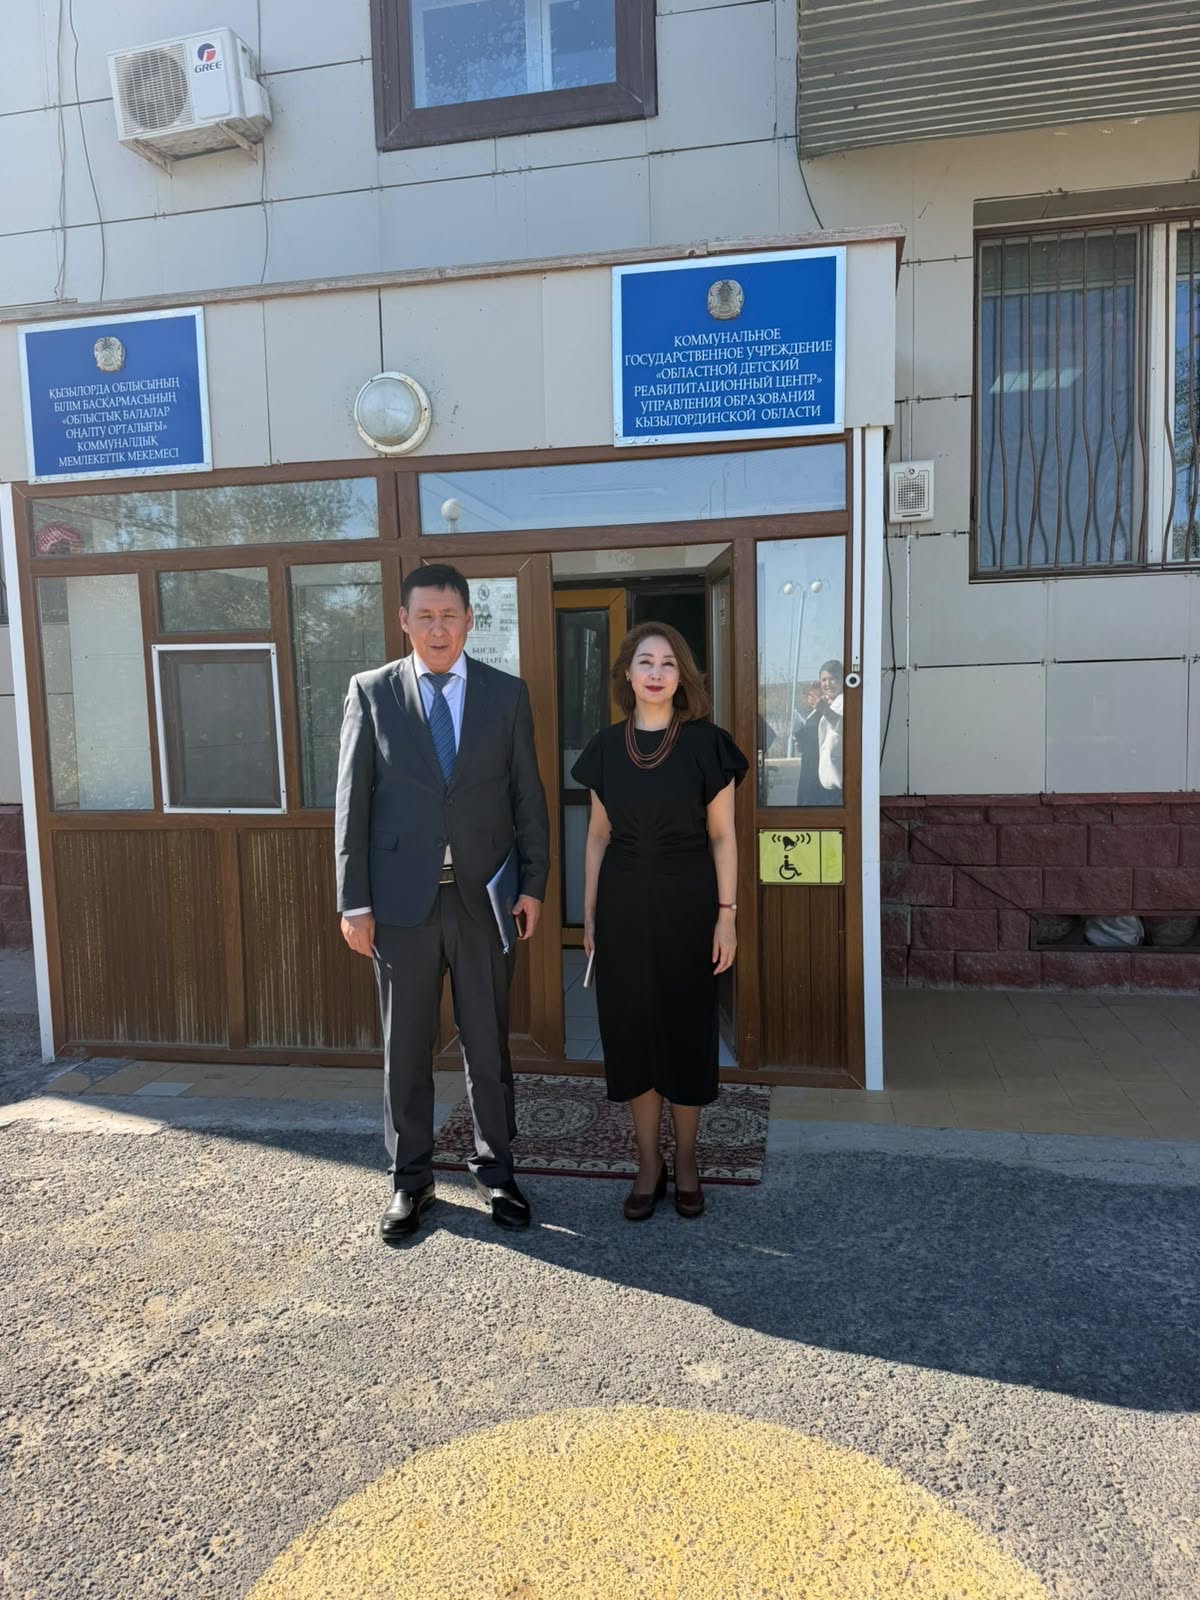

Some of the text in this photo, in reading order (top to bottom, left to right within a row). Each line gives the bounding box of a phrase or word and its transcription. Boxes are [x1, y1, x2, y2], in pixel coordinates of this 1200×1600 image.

[195, 61, 222, 73] GREE
[674, 328, 781, 348] КОММУНАЛЬНОЕ
[625, 340, 833, 367] ГОСУДАРСТВЕННОЕ УЧРЕЖДЕНИЕ
[656, 357, 799, 380] «ОБЛАСТНОЙ ДЕТСКИЙ
[49, 377, 180, 399] ҚЫЗЫЛОРДА ОБЛЫСЫНЫҢ
[634, 373, 823, 397] РЕАБИЛИТАЦИОННЫЙ ЦЕНТР»
[54, 392, 177, 413] БІЛІМ БАСҚАРМАСЫНЫҢ
[640, 389, 816, 414] УПРАВЛЕНИЯ ОБРАЗОВАНИЯ
[123, 406, 170, 420] БАЛАЛАР
[635, 405, 821, 428] КЫЗЫЛОРДИНСКОЙ ОБЛАСТИ
[59, 448, 179, 467] МЕМЛЕКЕТТІК МЕКЕМЕСІ
